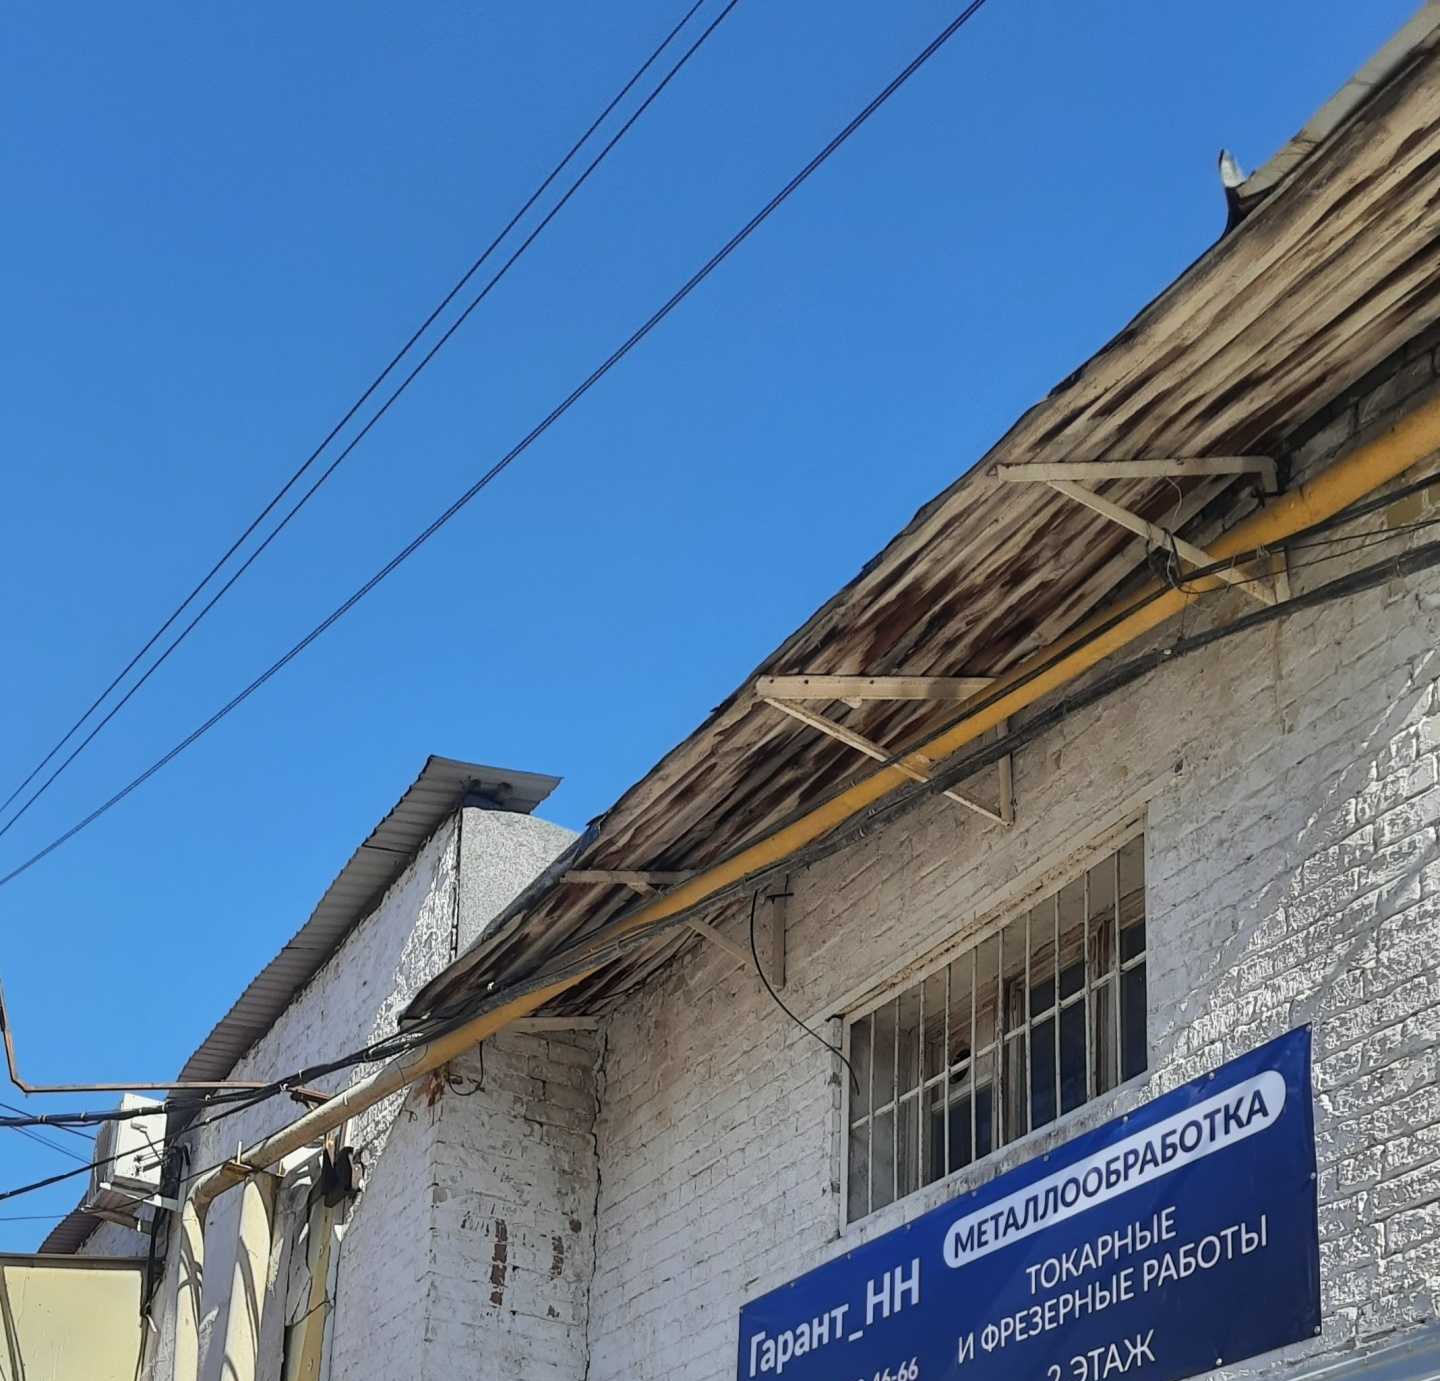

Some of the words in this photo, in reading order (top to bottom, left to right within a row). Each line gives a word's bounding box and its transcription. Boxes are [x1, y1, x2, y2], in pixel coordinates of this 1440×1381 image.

[954, 1088, 1269, 1259] МЕТАЛЛООБРАБОТКА
[749, 1257, 920, 1378] Гарант_НН
[958, 1332, 975, 1364] И
[981, 1267, 1135, 1352] ФРЕЗЕРНЫЕ
[1143, 1214, 1267, 1292] РАБОТЫ
[1025, 1206, 1177, 1294] ТОКАРНЫЕ
